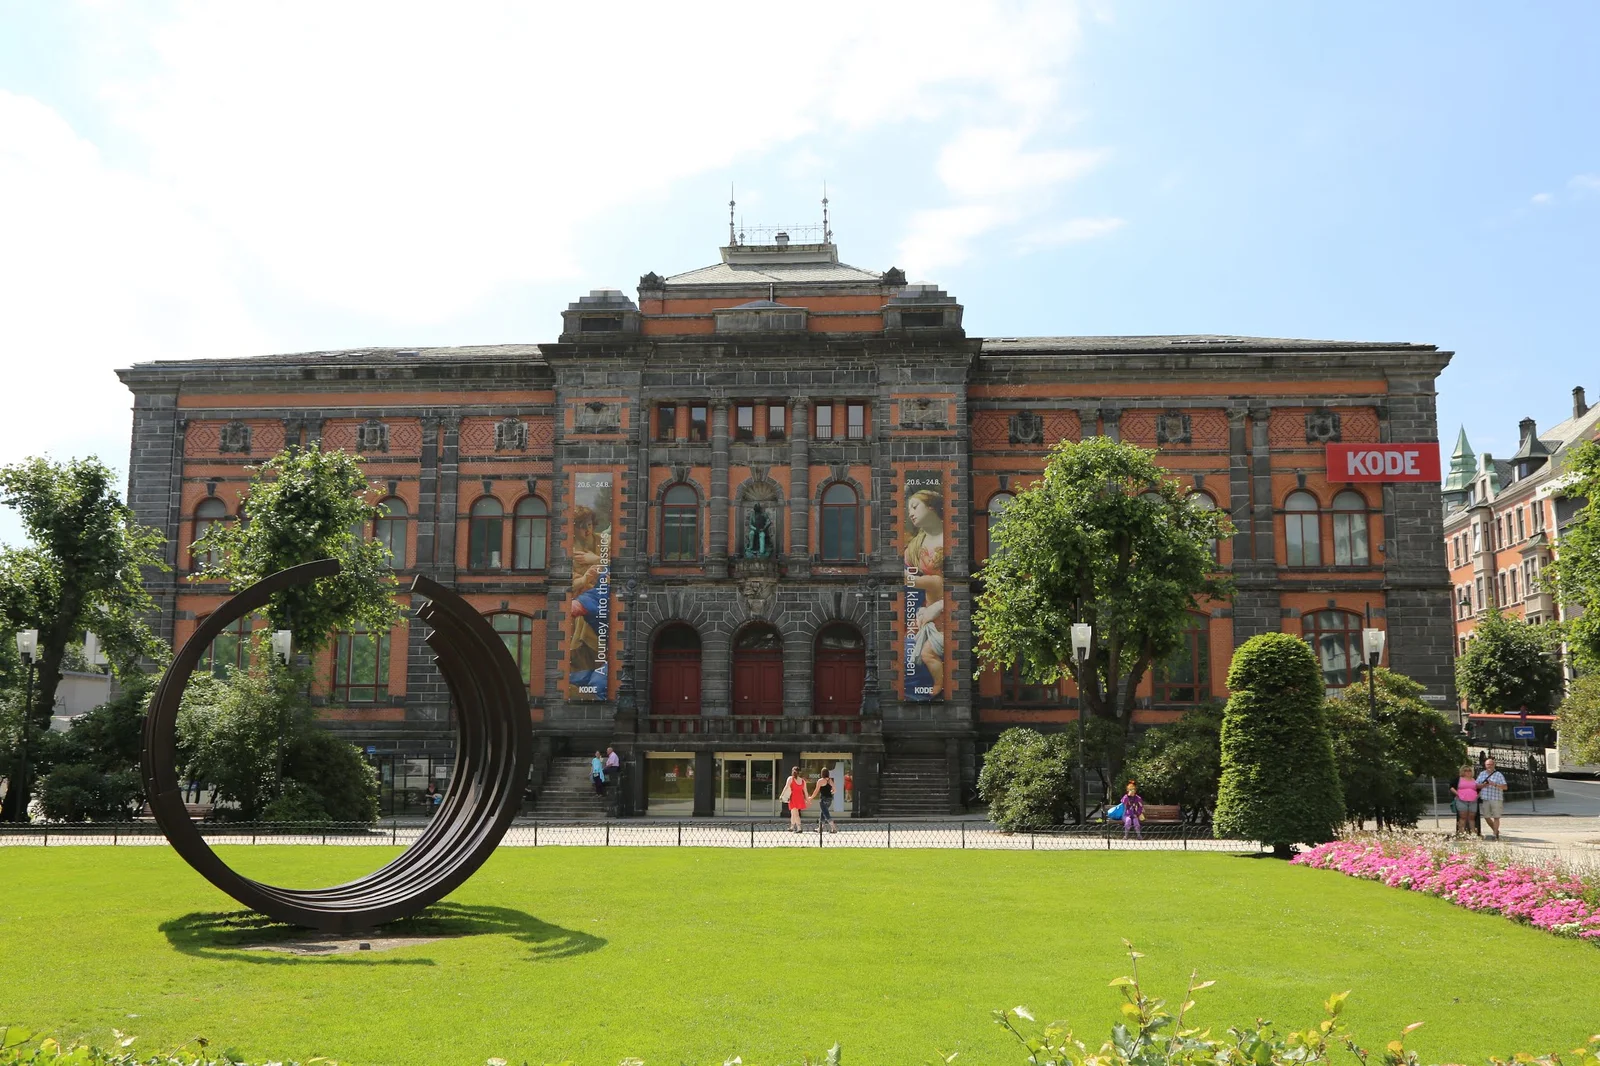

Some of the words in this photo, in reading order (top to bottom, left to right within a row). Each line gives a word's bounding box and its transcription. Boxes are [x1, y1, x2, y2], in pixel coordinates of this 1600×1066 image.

[1347, 451, 1420, 475] KODE
[597, 532, 609, 574] Classics
[596, 577, 608, 595] the
[906, 566, 919, 588] Den
[596, 598, 608, 619] into
[906, 591, 919, 640] klassiske
[595, 621, 609, 664] Journey
[594, 666, 606, 675] A
[906, 642, 918, 676] reisen
[579, 686, 598, 694] KODE
